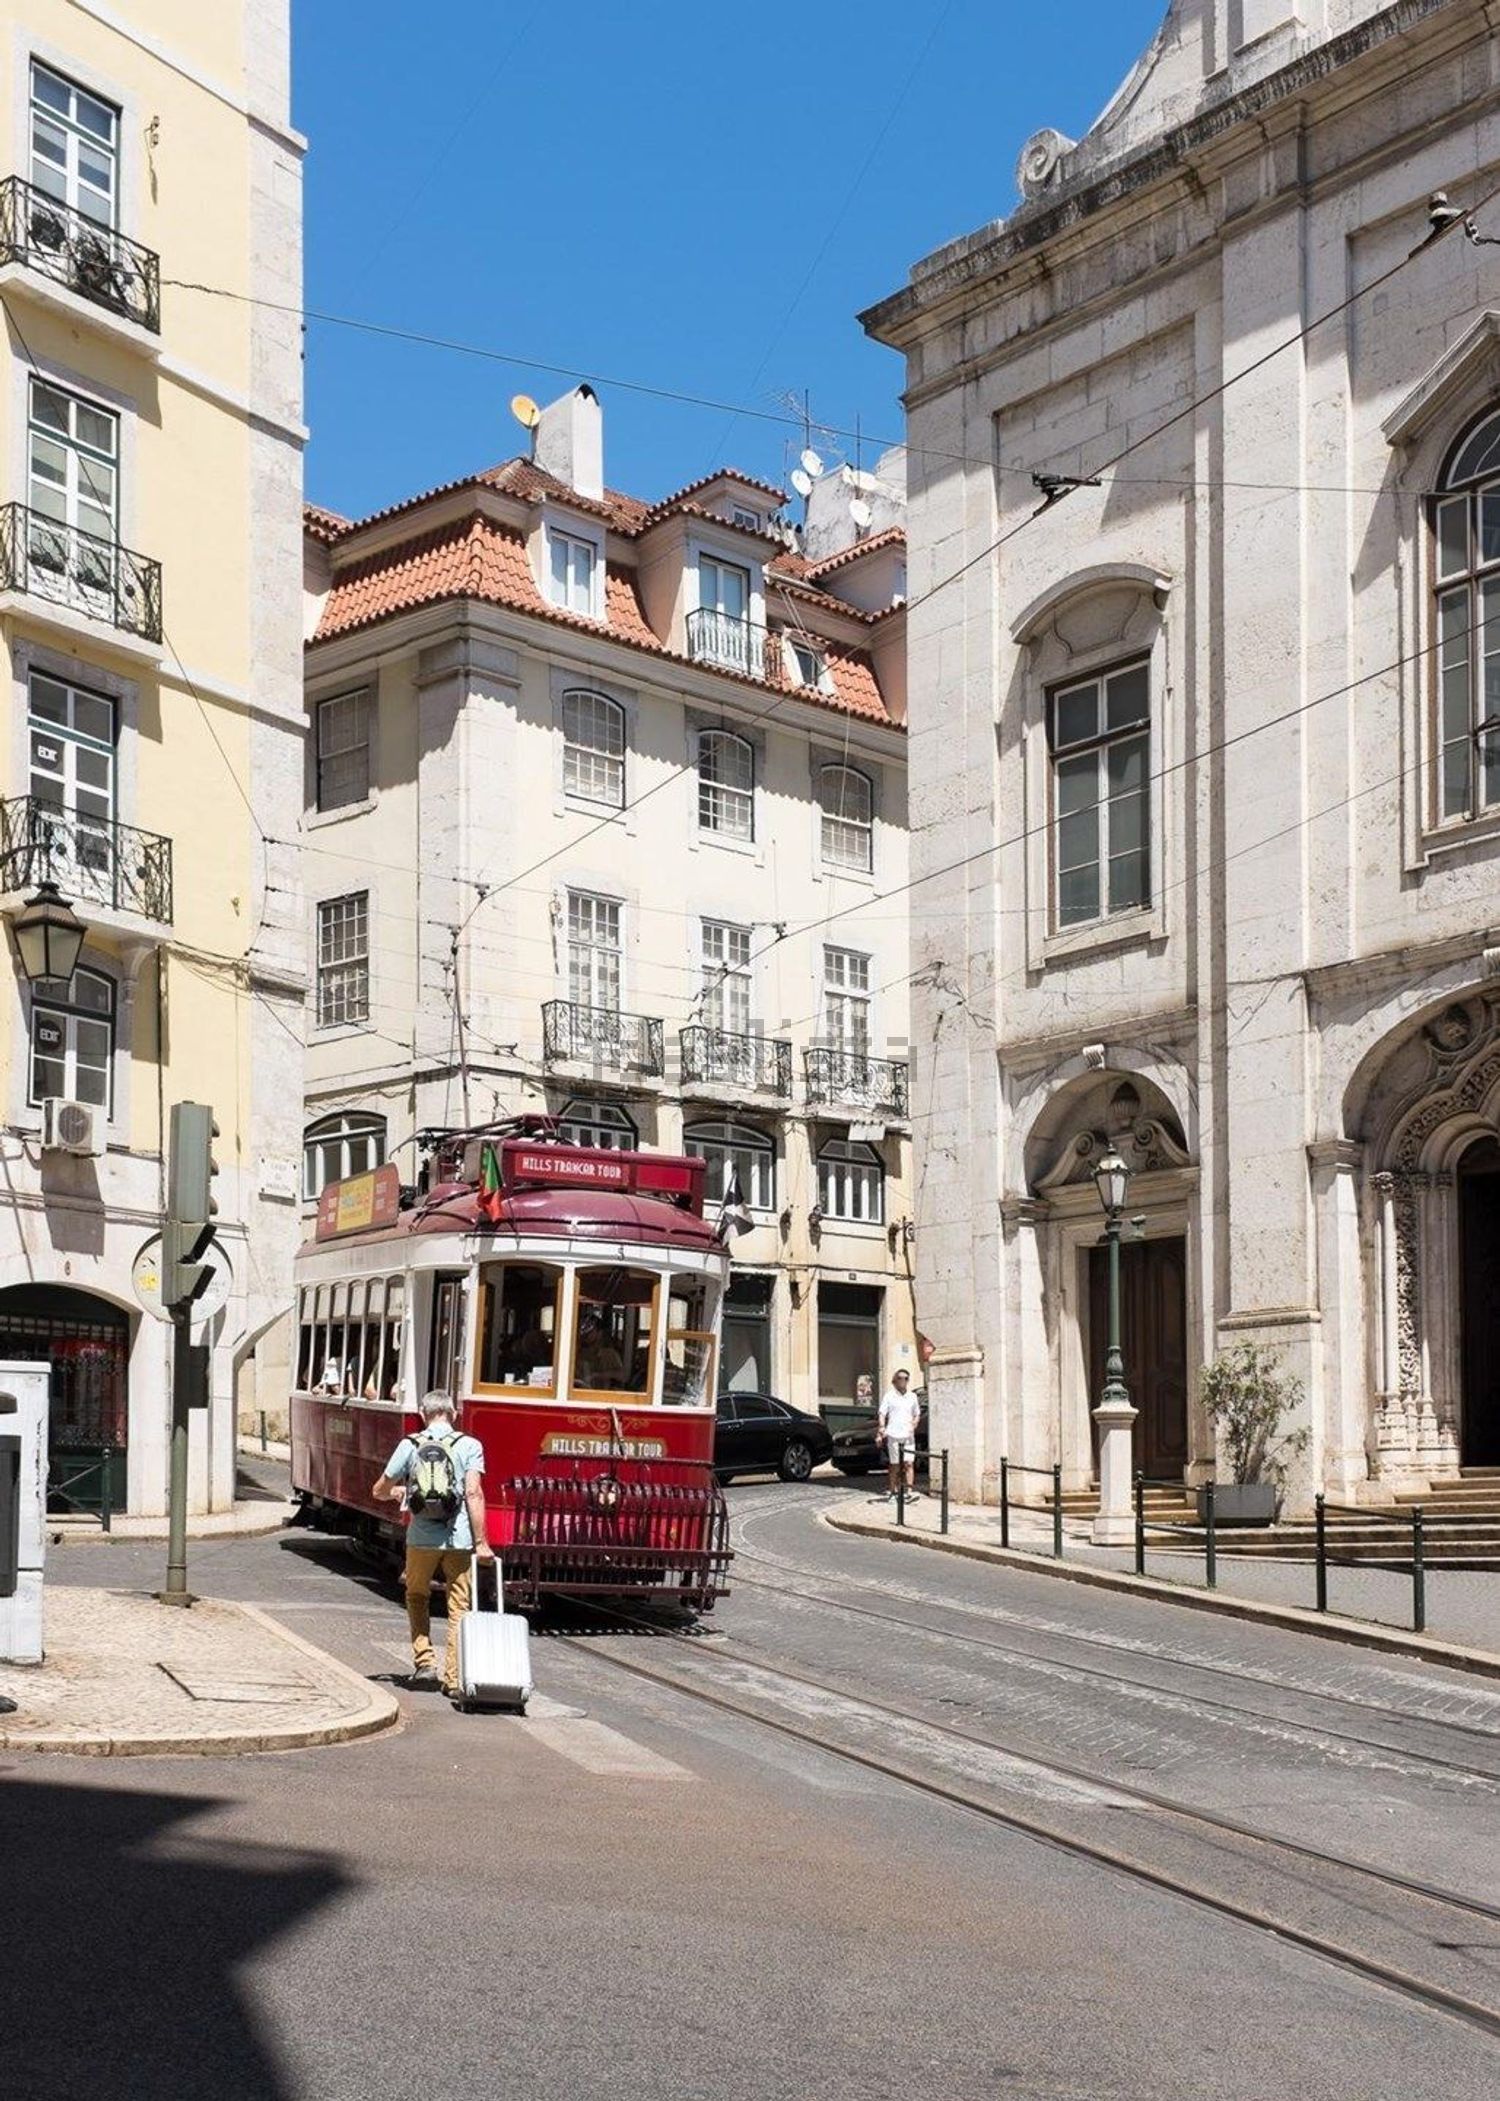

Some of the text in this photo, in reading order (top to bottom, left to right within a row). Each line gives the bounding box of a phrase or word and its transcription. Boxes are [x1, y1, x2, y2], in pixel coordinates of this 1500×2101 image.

[522, 1157, 552, 1172] HILLS
[598, 1164, 622, 1179] TOUR
[551, 1438, 586, 1454] HILLS
[638, 1442, 663, 1458] TOUR
